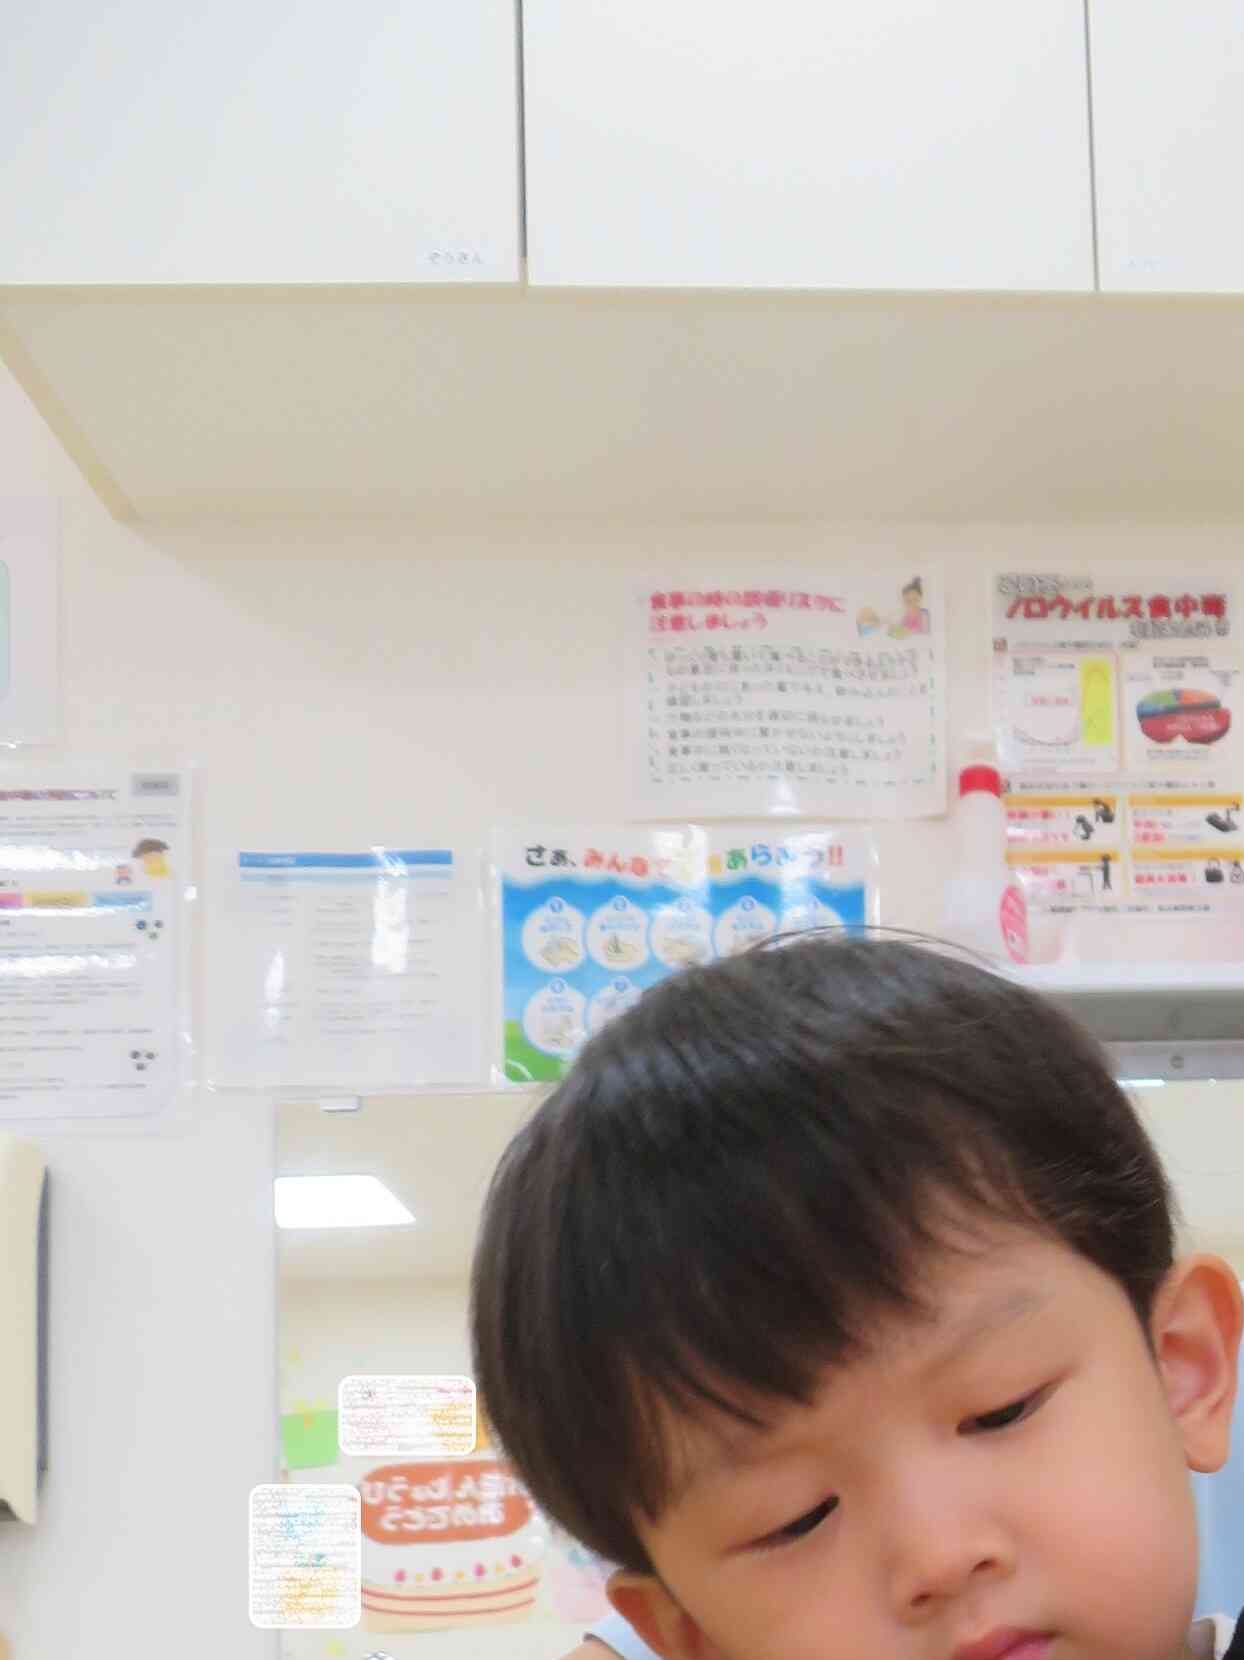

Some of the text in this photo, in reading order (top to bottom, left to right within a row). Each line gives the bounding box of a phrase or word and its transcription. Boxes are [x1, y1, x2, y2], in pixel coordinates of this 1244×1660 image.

[1005, 593, 1228, 621] ノロウイルス食中毒
